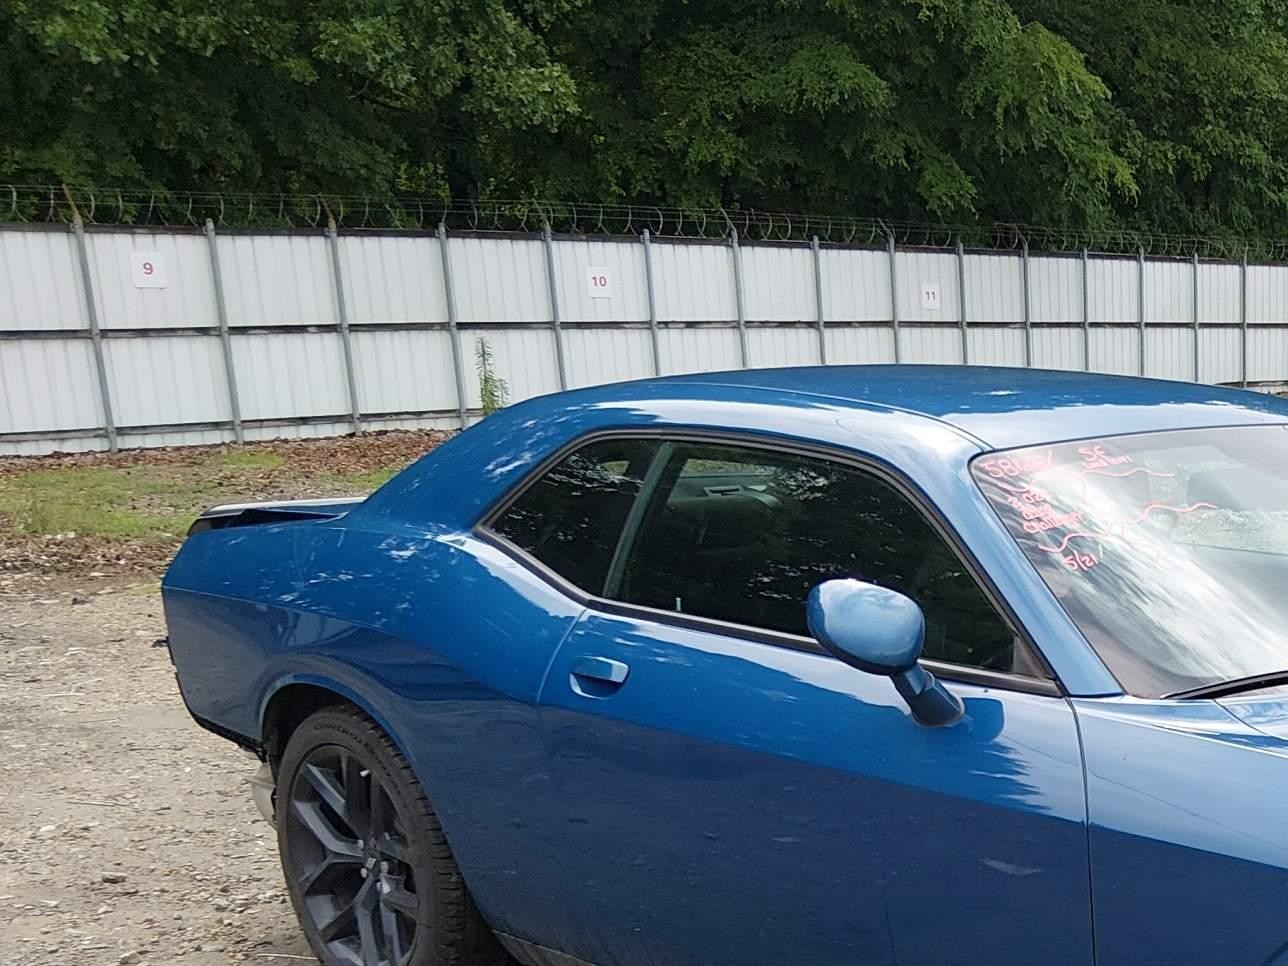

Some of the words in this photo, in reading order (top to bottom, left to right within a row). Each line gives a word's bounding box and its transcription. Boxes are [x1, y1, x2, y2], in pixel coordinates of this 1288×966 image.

[143, 262, 154, 275] 9
[591, 275, 607, 287] 10
[926, 290, 936, 301] 11
